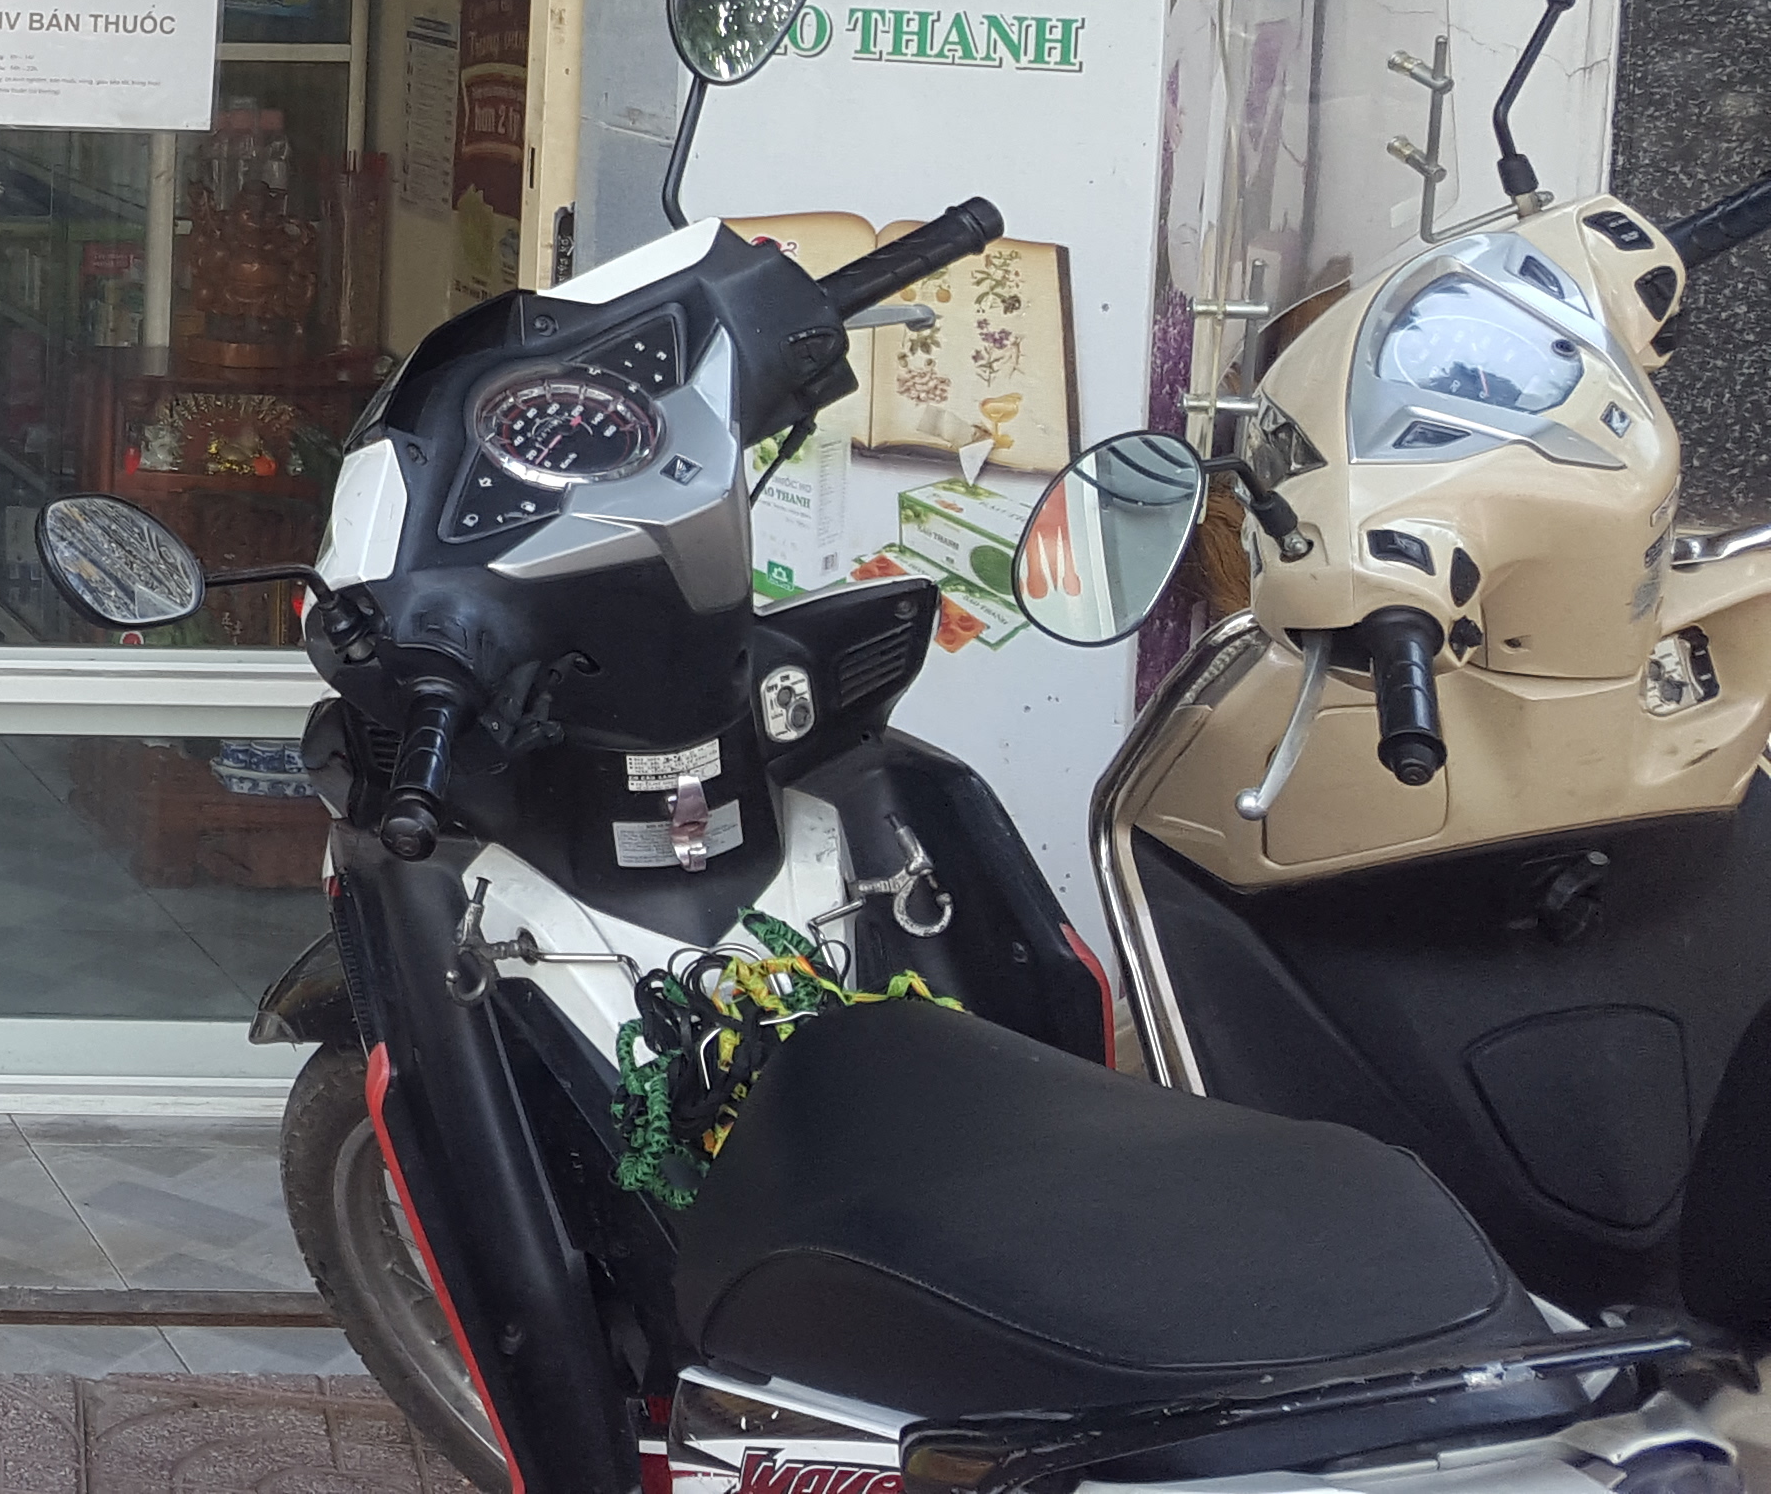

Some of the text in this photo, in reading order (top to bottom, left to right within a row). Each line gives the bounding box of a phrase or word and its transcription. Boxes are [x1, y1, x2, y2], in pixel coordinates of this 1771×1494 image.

[28, 9, 81, 33] BÁN
[89, 5, 176, 35] THUỐC
[846, 8, 1085, 73] THANH
